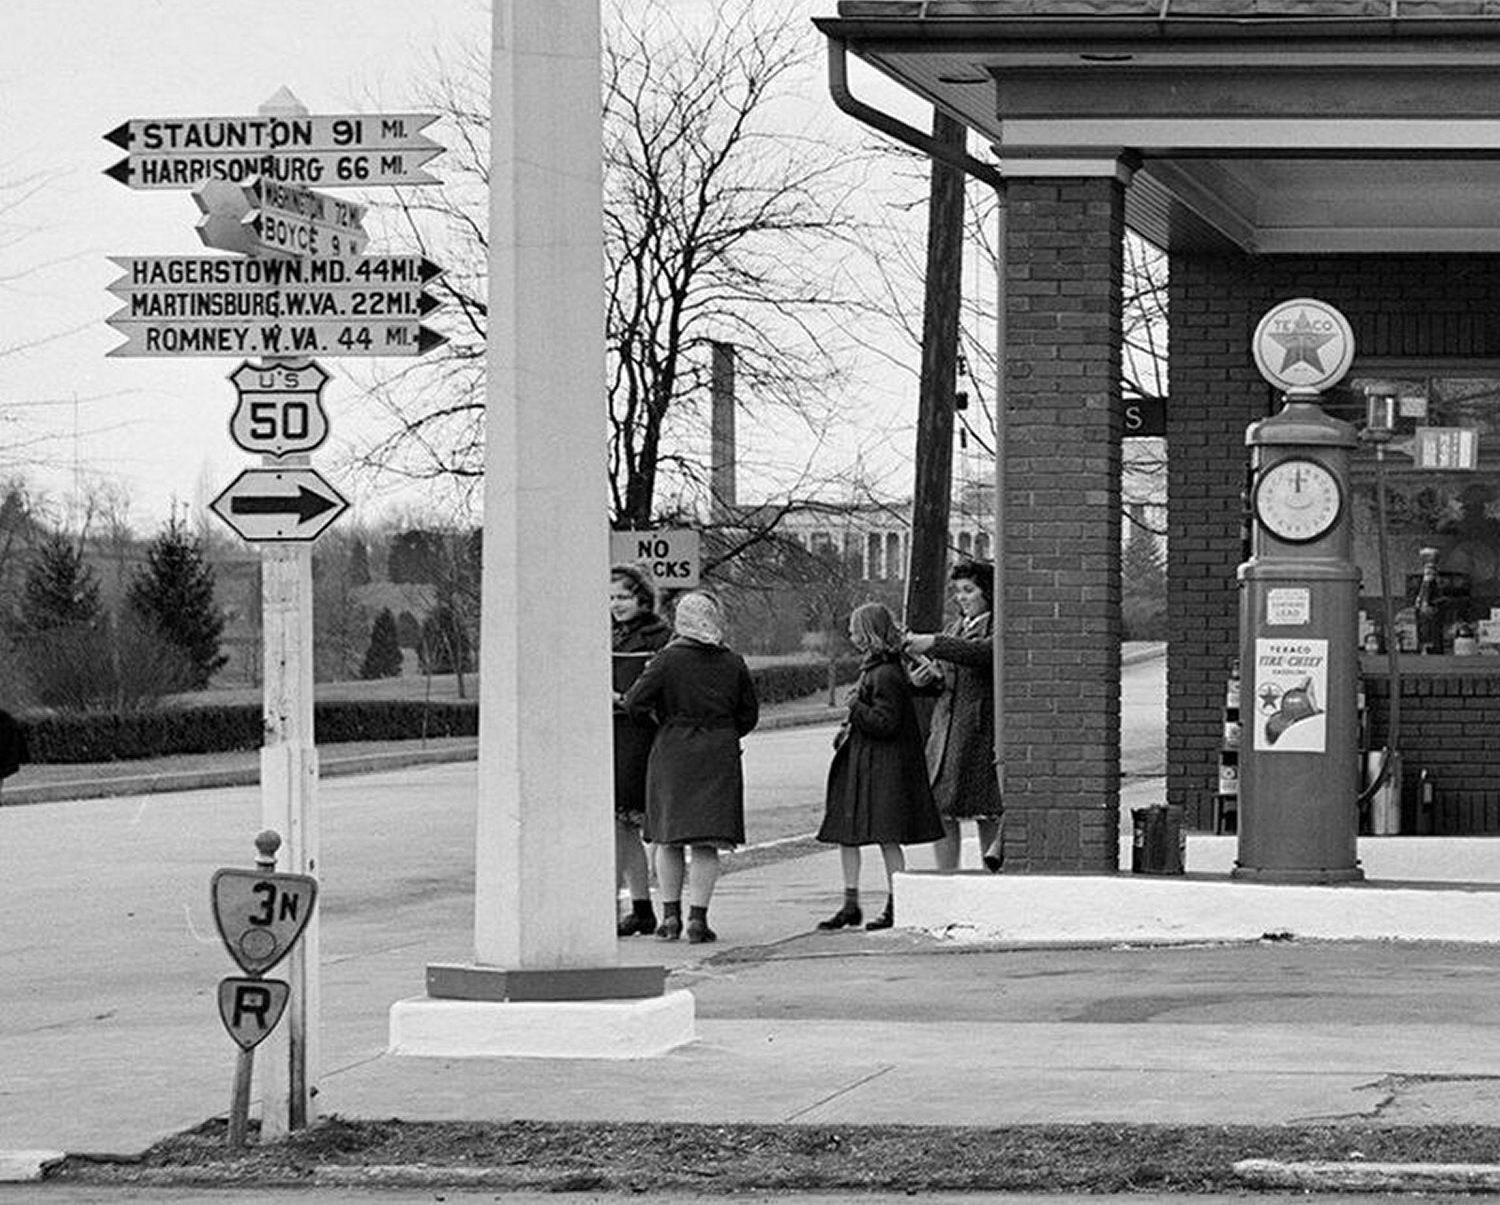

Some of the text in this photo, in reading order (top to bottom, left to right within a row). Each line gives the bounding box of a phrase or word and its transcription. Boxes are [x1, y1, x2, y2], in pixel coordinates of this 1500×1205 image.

[143, 120, 312, 149] STAUNTON
[332, 120, 362, 145] 91
[141, 156, 325, 184] HARRISONBURG
[337, 156, 369, 180] 66
[264, 216, 319, 256] BOYCE
[337, 327, 372, 349] 44
[250, 403, 309, 439] 50
[637, 540, 669, 558] NO
[232, 986, 271, 1029] R
